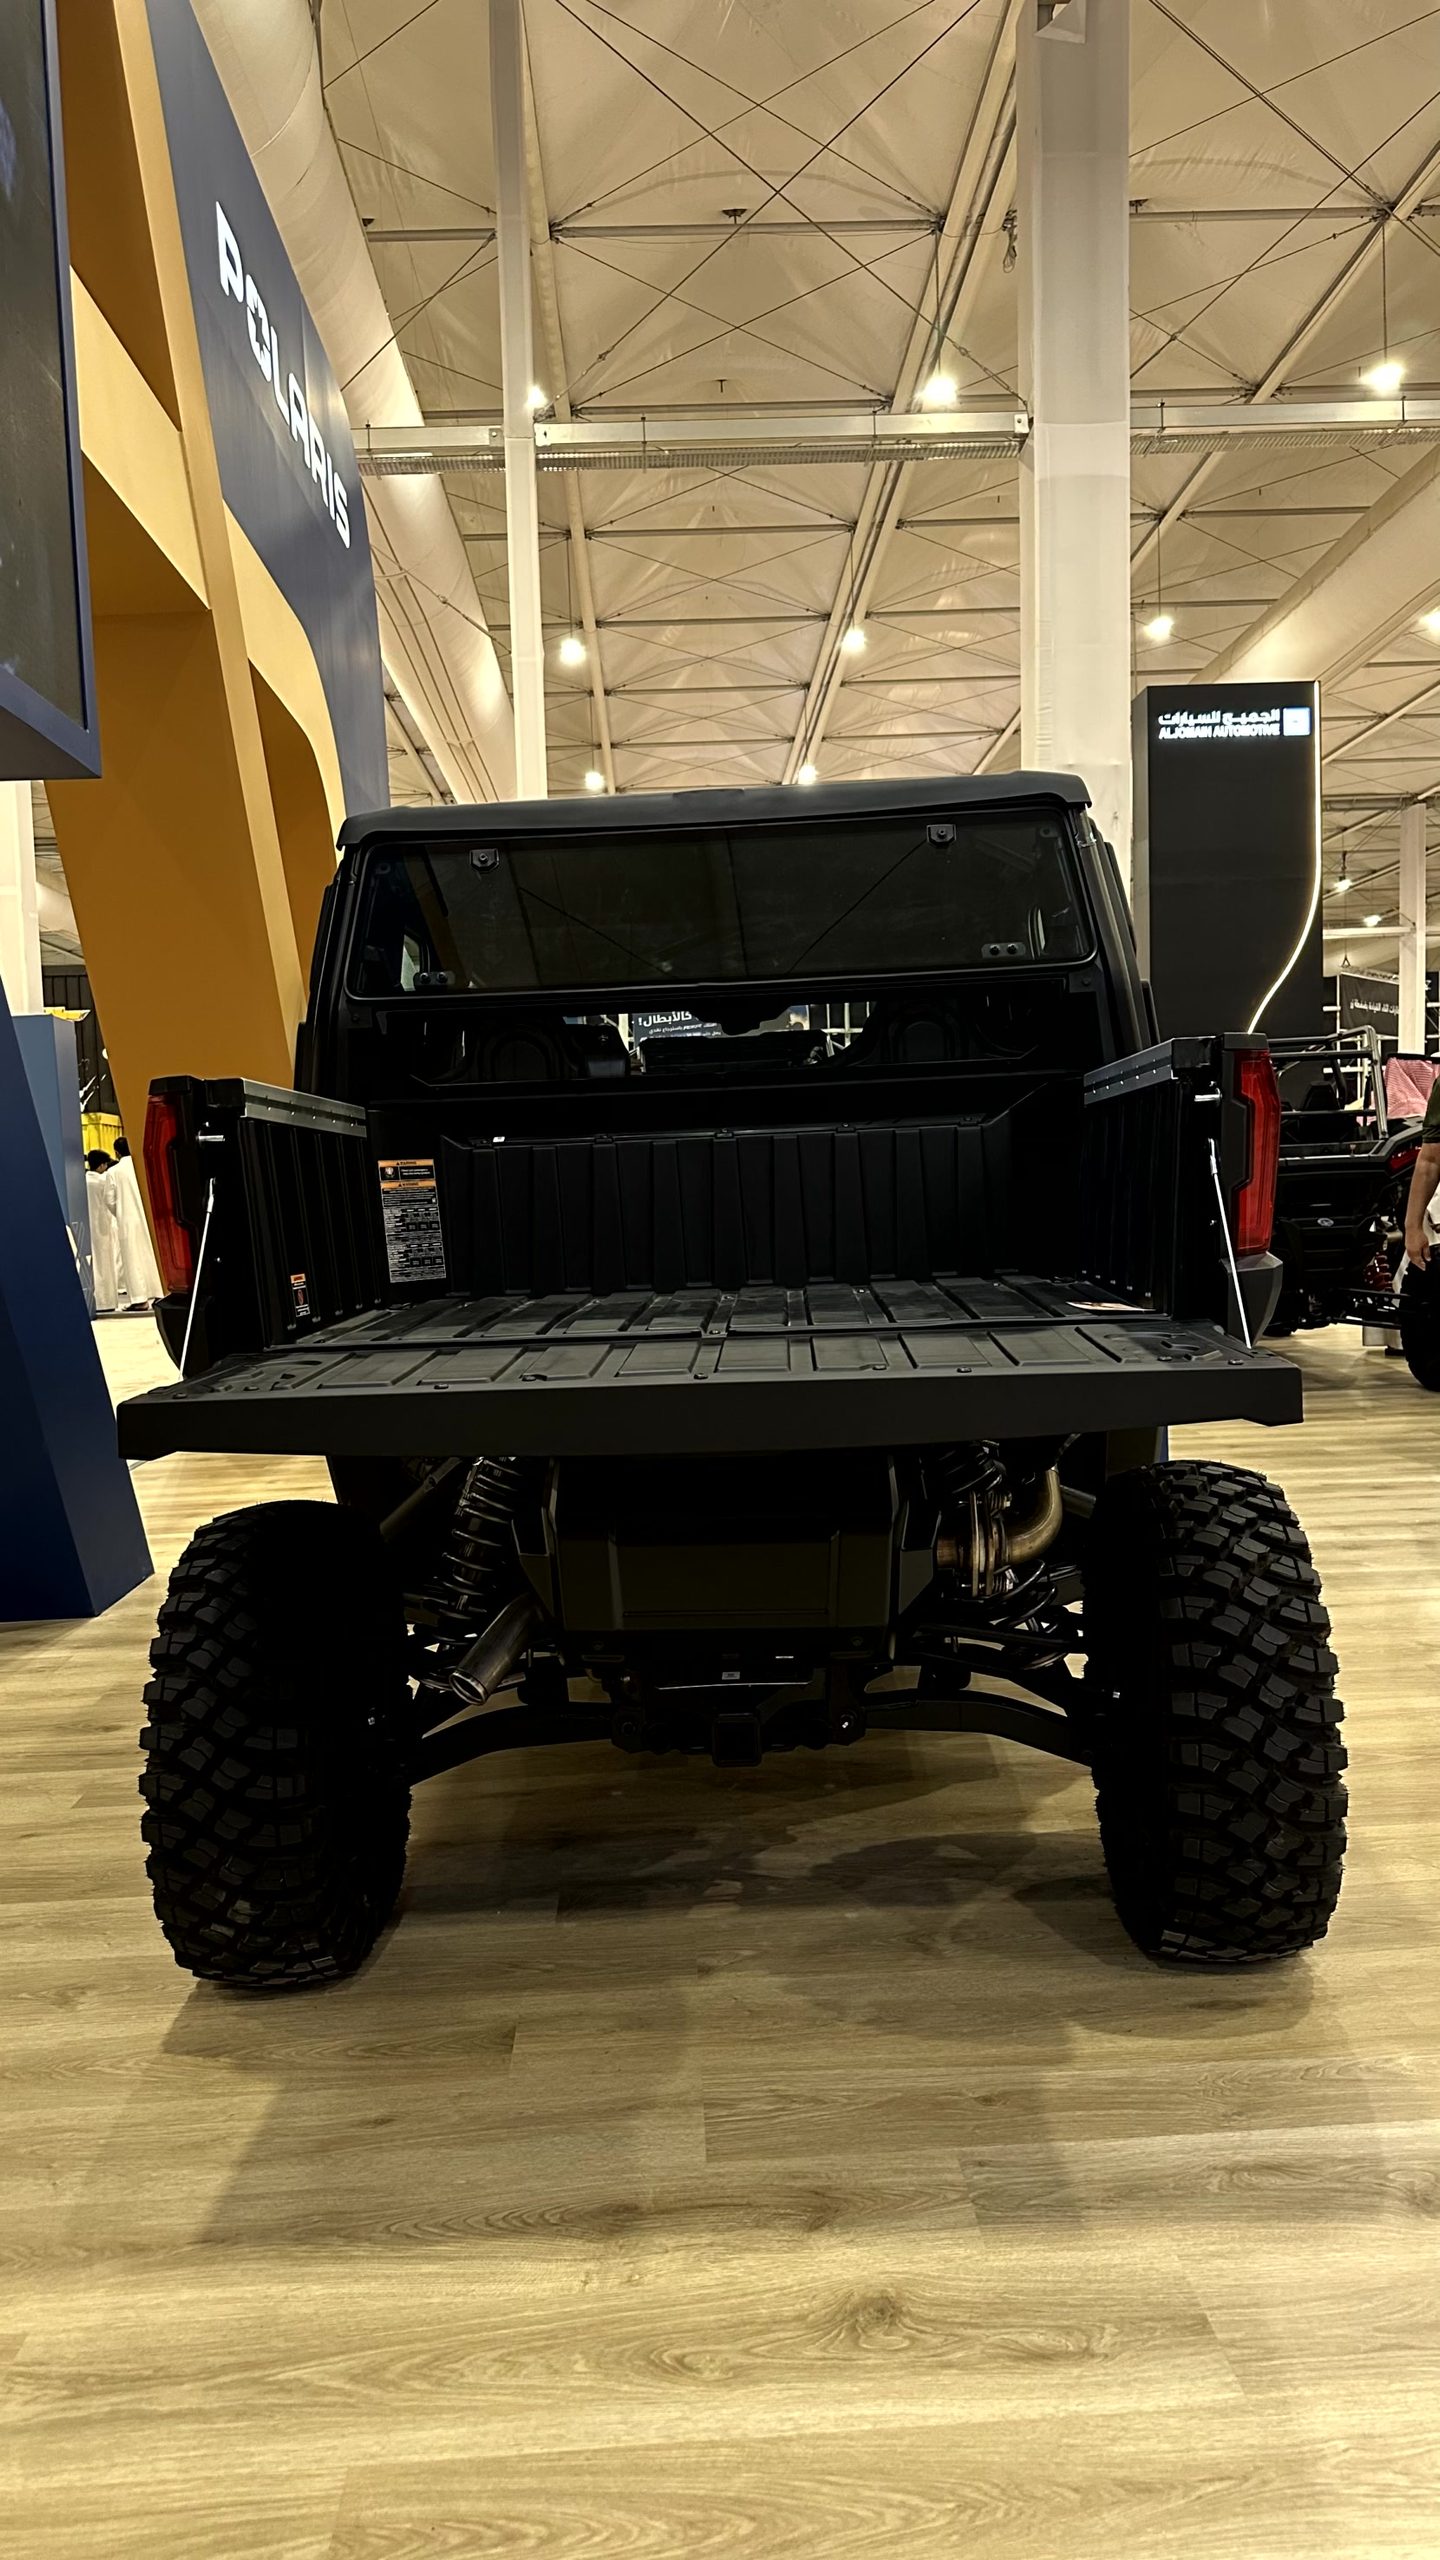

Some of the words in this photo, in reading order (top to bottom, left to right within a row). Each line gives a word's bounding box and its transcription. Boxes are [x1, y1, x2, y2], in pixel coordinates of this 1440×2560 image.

[215, 201, 351, 550] POLARIS
[1158, 710, 1221, 726] للسيارات
[1222, 708, 1280, 725] الجميع
[1213, 723, 1280, 738] AUTOMOTIVE
